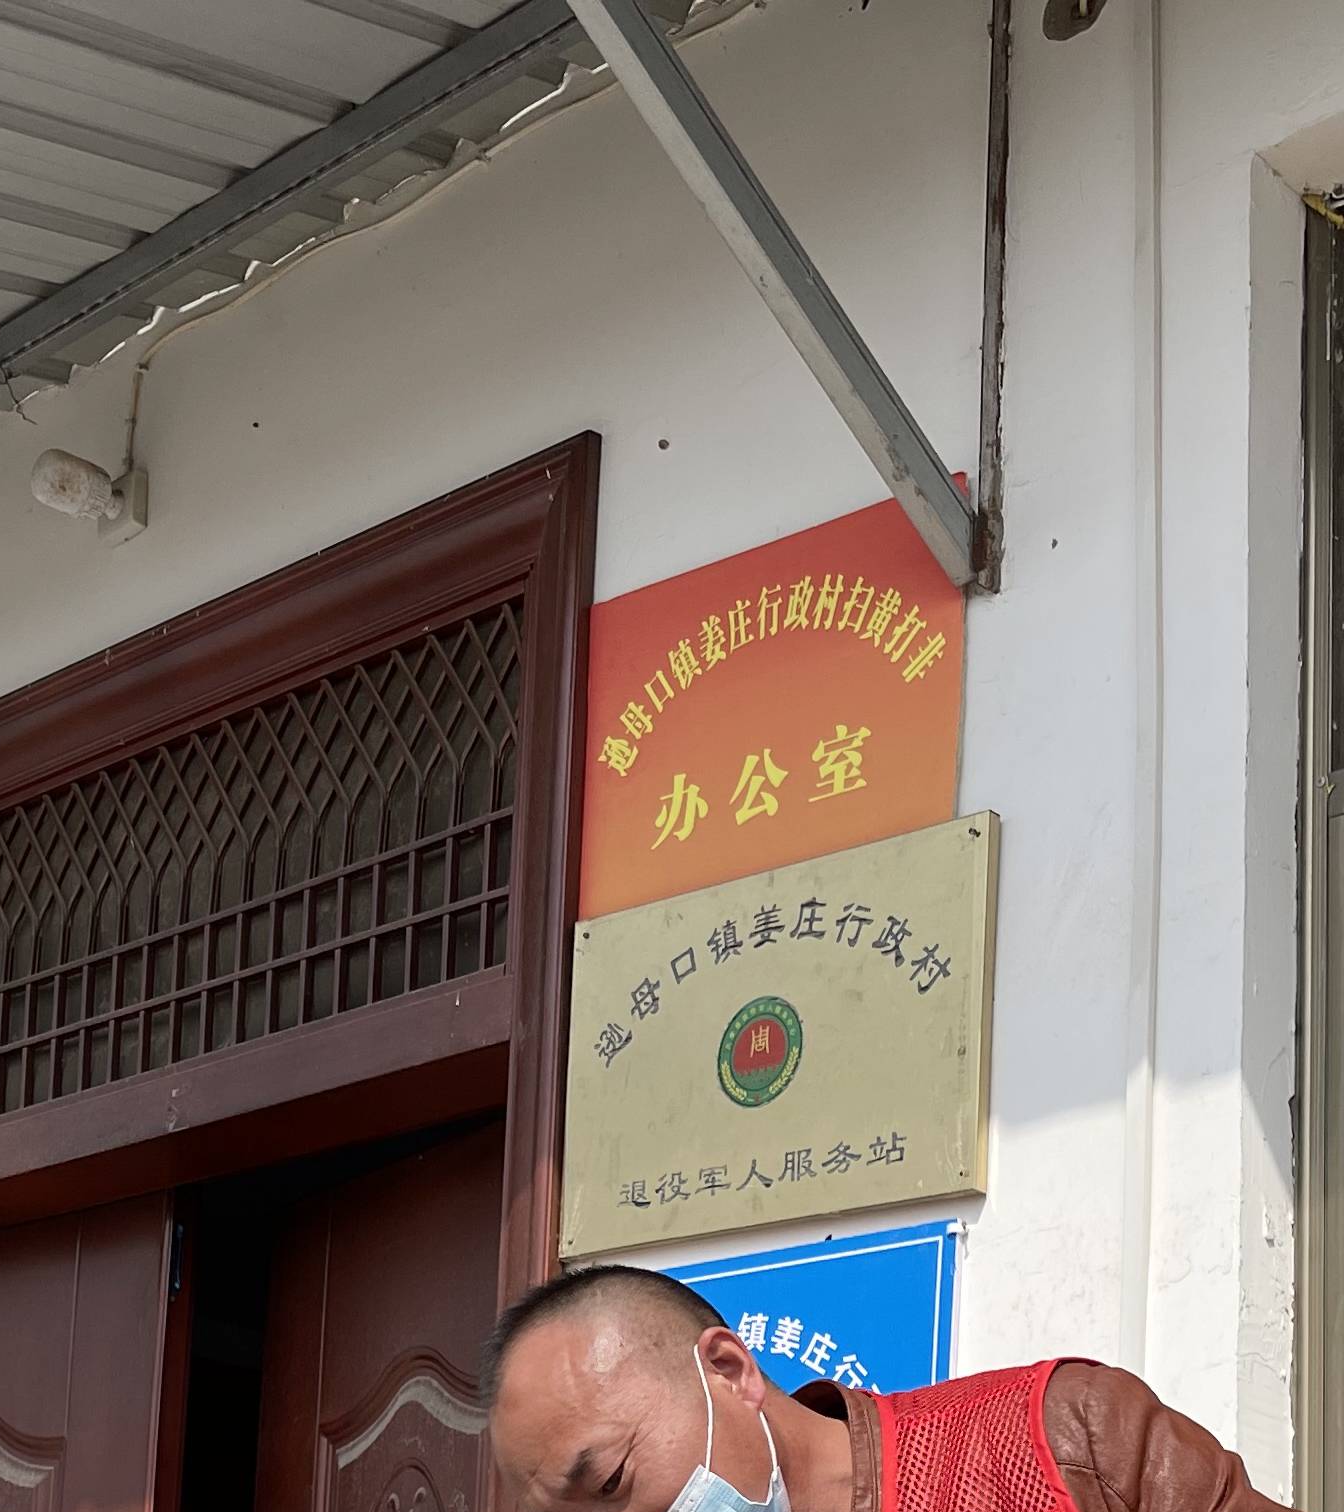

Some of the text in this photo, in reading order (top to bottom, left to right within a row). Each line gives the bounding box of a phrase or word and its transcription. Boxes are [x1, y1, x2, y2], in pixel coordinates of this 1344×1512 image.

[597, 574, 947, 777] 逊母口镇姜庄行政村扫黄打非
[651, 724, 872, 850] 办公室
[593, 897, 952, 1067] 逊母口镇姜庄行政村
[617, 1132, 908, 1210] 退役军人服务站
[737, 1312, 881, 1394] 镇姜庄行
